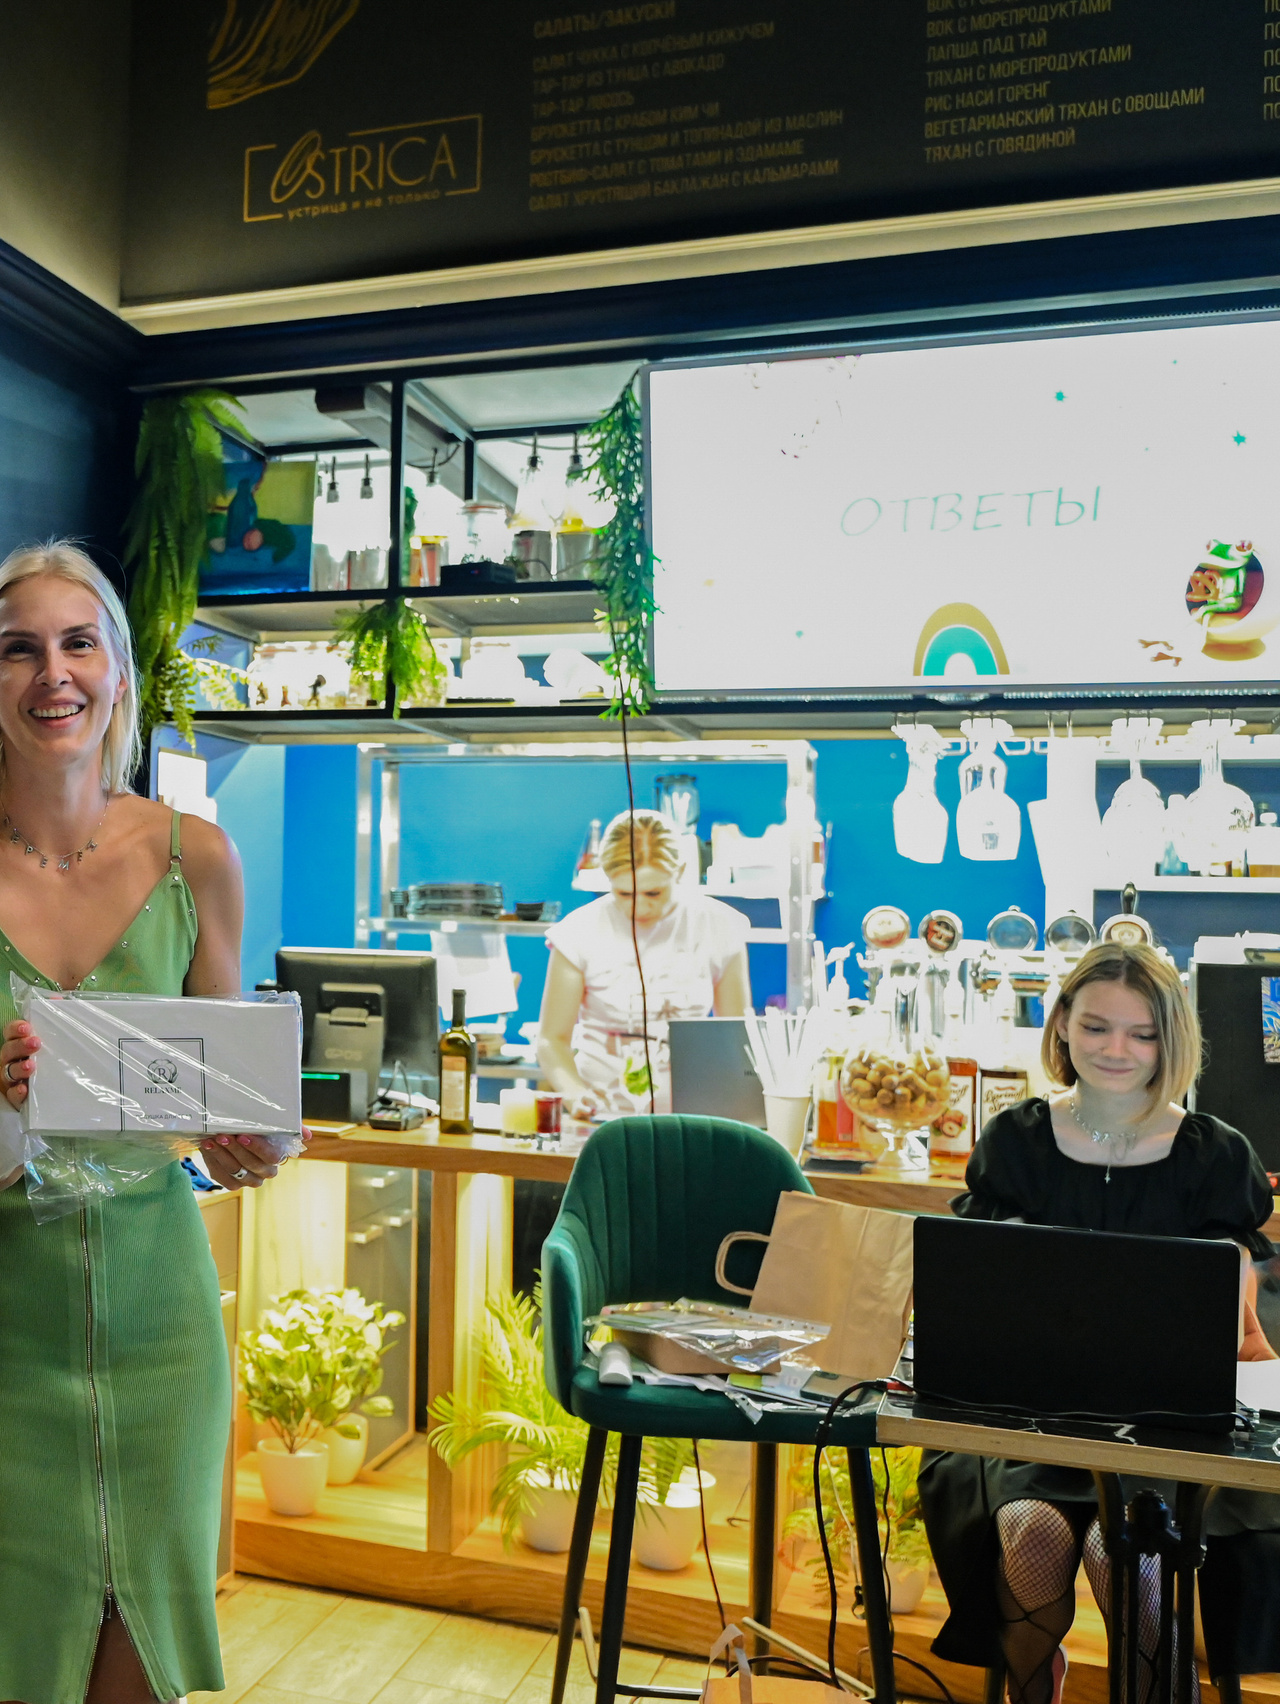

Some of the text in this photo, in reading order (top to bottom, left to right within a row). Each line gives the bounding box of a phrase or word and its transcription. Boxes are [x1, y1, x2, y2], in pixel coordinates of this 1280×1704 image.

[926, 19, 954, 38] ВОК
[957, 16, 967, 33] С
[970, 0, 1112, 31] МОРЕПРОДУКТАМИ
[926, 28, 1048, 63] ЛАПША ПАД ТАЙ
[652, 62, 660, 78] С
[663, 53, 725, 76] АВОКАДО
[926, 43, 1132, 89] ТЯХАН С МОРЕПРОДУКТАМИ
[924, 82, 1051, 113] РИС НАСИ ГОРЕНГ
[924, 86, 1205, 139] ВЕГЕТАРИАНСКИЙ ТЯХАН С ОВОЩАМИ
[603, 140, 612, 155] С
[765, 117, 782, 134] ИЗ
[785, 108, 844, 131] МАСЛИН
[604, 116, 613, 132] С
[637, 159, 646, 175] С
[736, 138, 805, 162] ЭДАМАМЕ
[924, 127, 1076, 164] ТЯХАН С ГОВЯДИНОЙ
[270, 130, 456, 204] OSTRICA
[654, 173, 729, 196] БАКЛАЖАН
[731, 170, 741, 187] С
[743, 158, 839, 186] КАЛЬМАРАМИ
[840, 485, 1102, 537] ОТВЕТЫ
